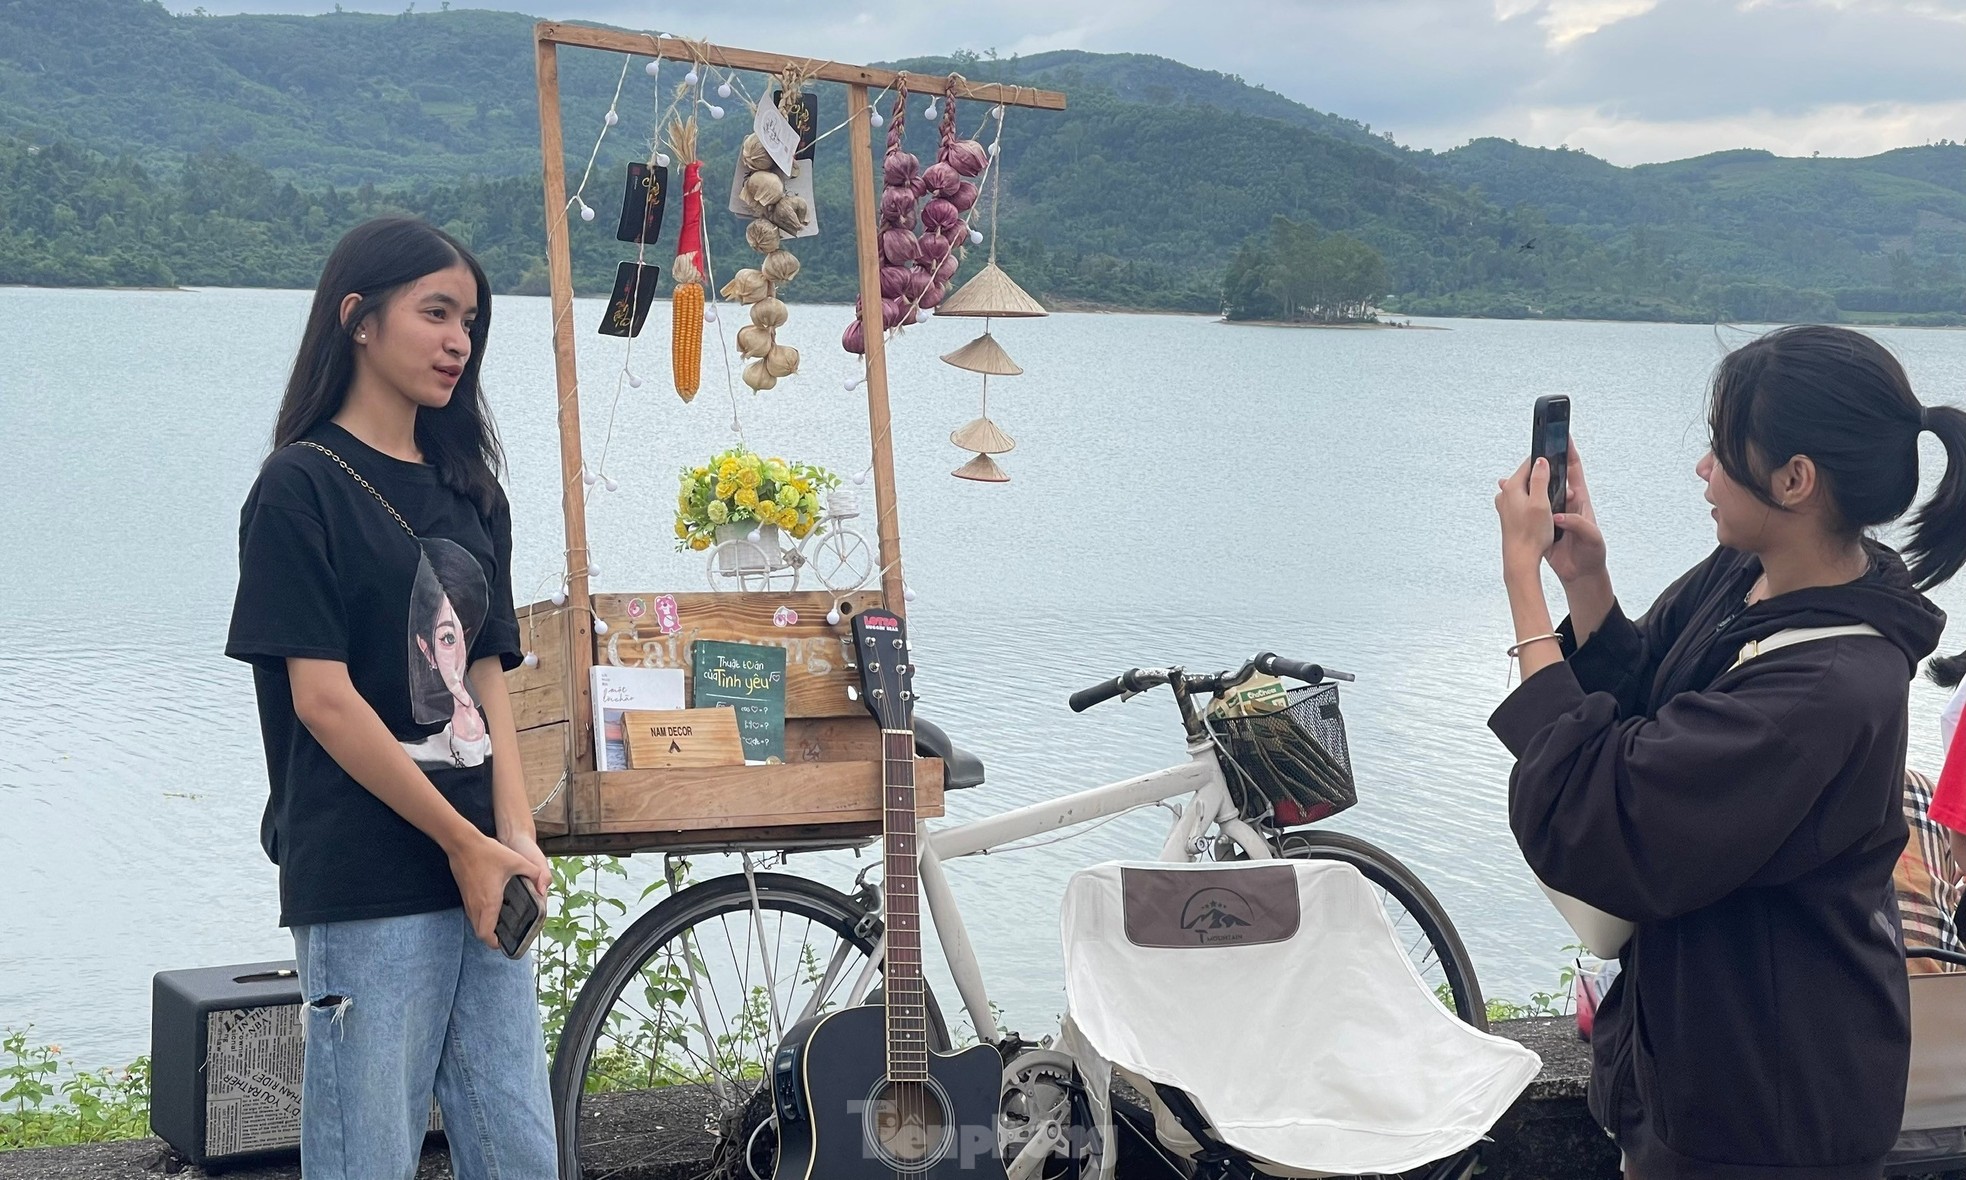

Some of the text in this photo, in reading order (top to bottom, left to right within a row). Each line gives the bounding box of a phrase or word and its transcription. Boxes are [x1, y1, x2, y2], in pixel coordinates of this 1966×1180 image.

[717, 656, 740, 670] Thuật
[704, 669, 717, 680] của
[713, 669, 741, 688] Tình
[745, 673, 769, 695] yêu
[650, 726, 693, 737] NAM DECOR
[238, 1021, 248, 1032] IN
[248, 1018, 269, 1035] NBA
[223, 1074, 262, 1097] RATHER
[260, 1091, 280, 1107] YOU
[279, 1085, 303, 1104] THAN
